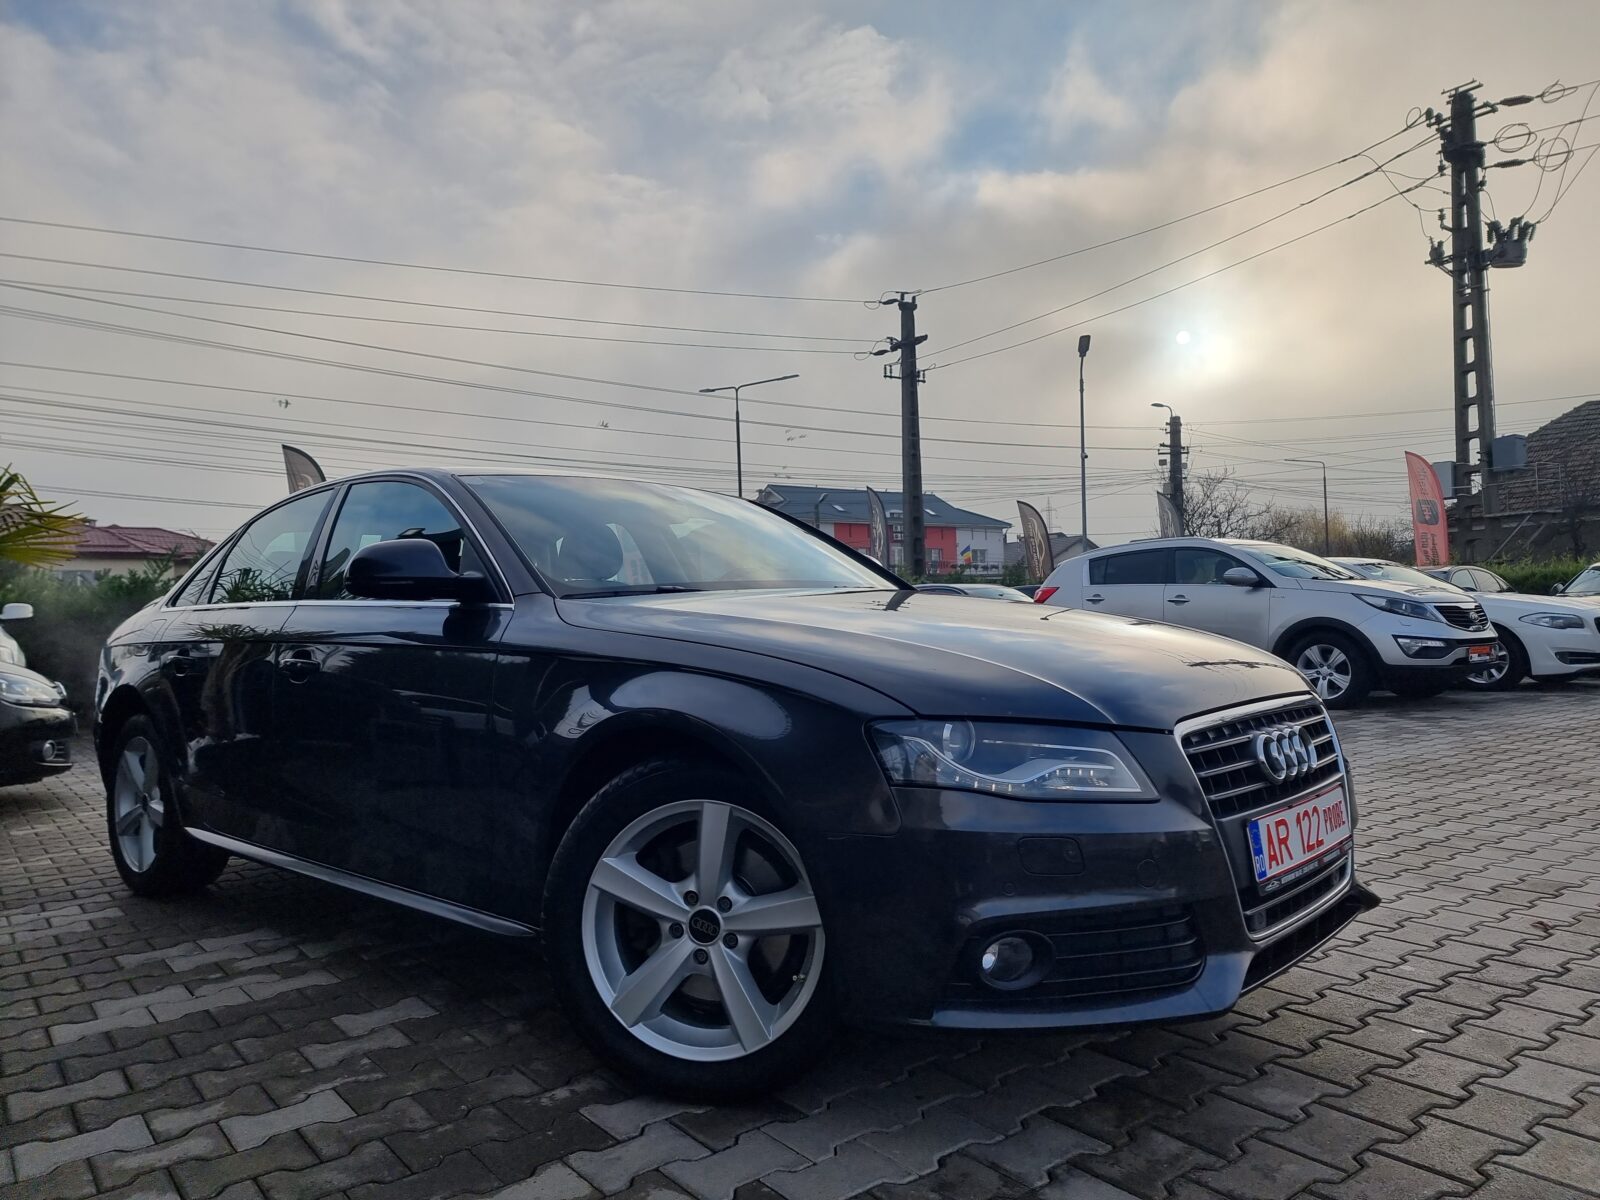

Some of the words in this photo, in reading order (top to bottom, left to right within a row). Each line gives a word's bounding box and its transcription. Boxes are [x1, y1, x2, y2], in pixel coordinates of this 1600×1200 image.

[1266, 819, 1293, 870] AR
[1296, 805, 1324, 855] 122
[1323, 800, 1346, 835] PROBE
[1255, 854, 1266, 873] RO
